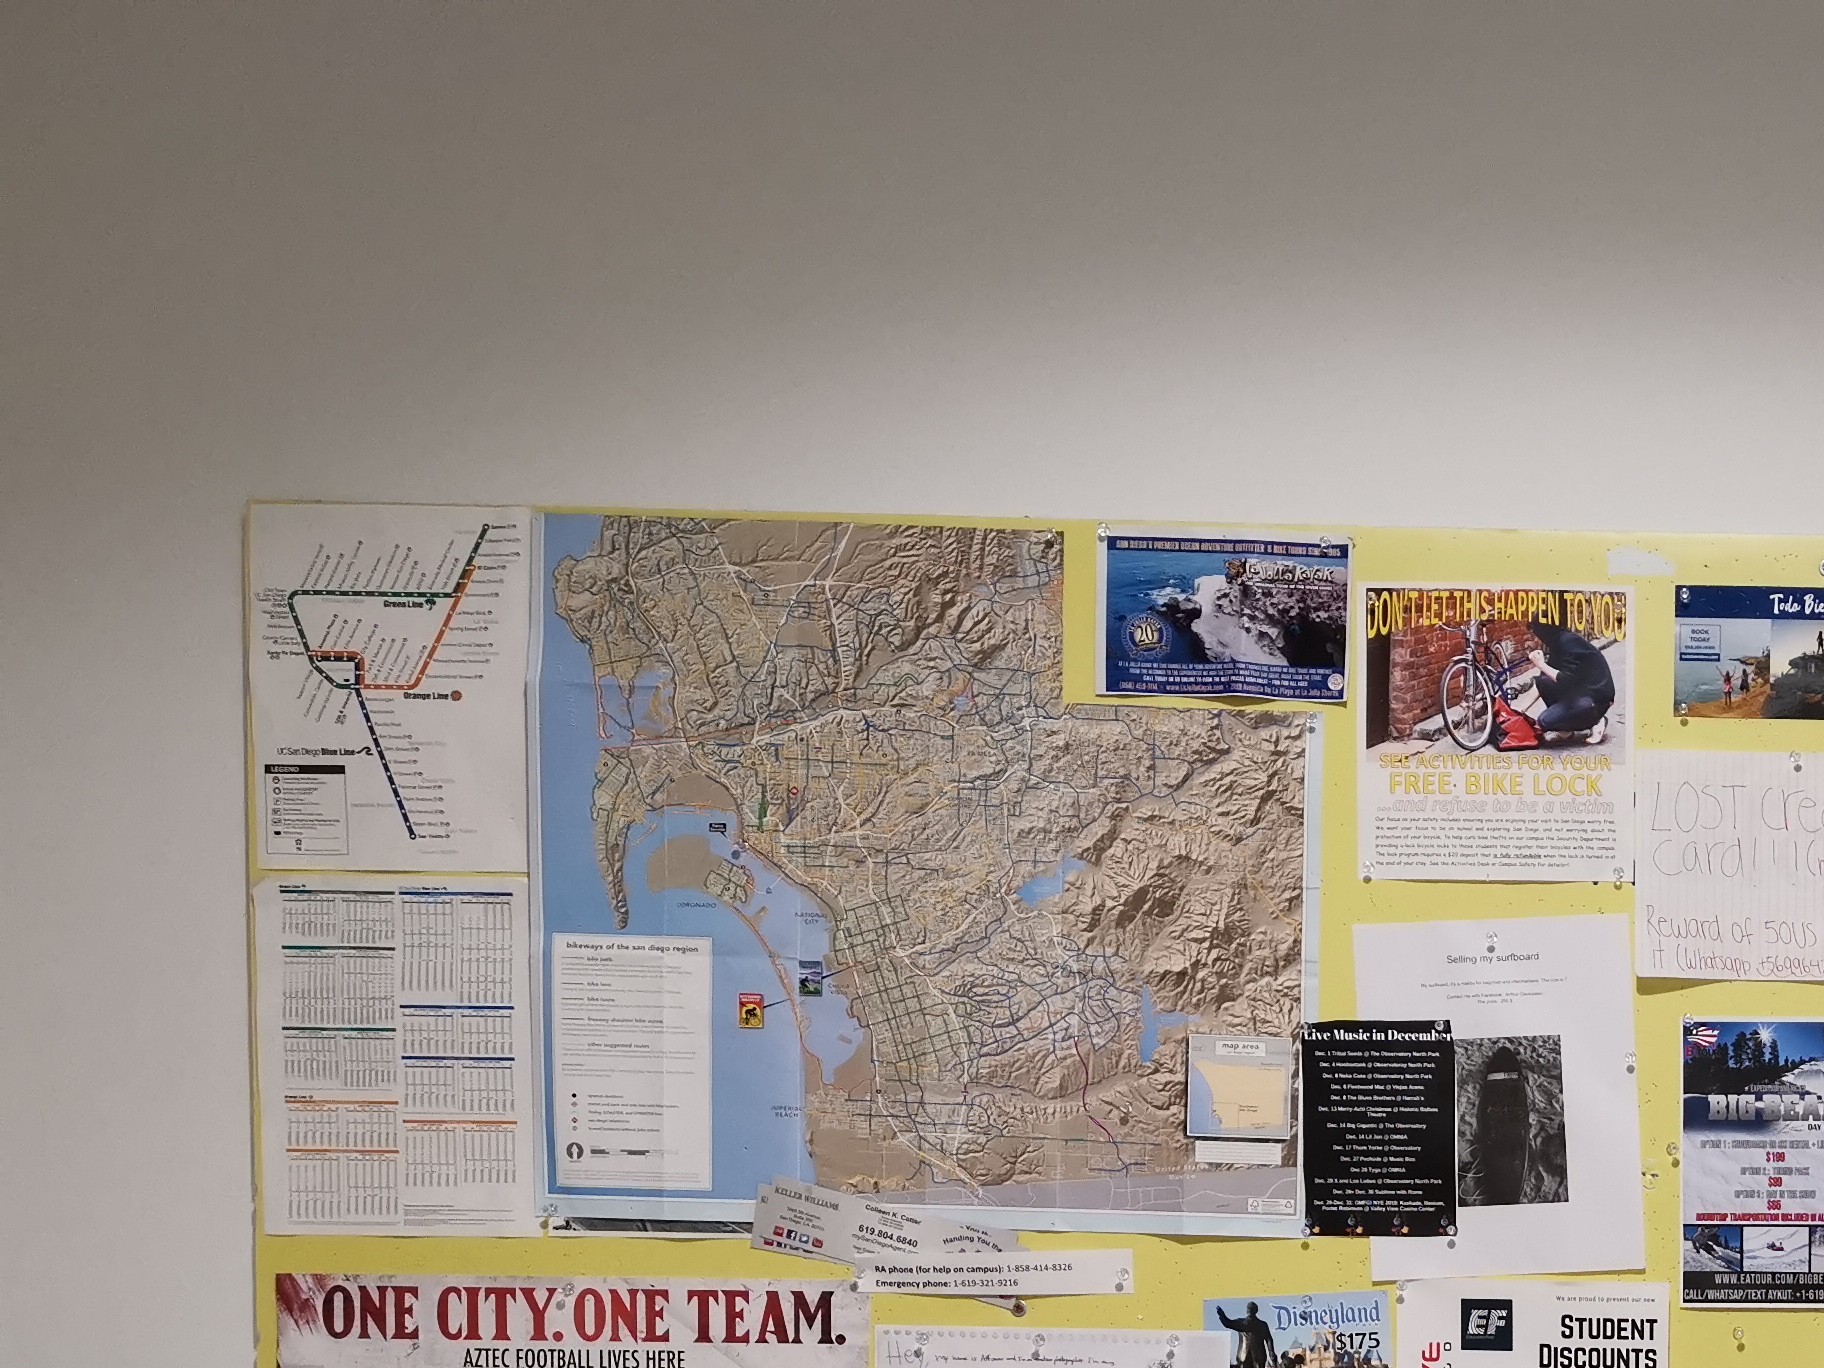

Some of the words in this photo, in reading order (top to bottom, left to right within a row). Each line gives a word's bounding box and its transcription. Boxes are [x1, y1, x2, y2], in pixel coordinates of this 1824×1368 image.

[383, 600, 405, 608] Green
[407, 601, 423, 609] Line
[1769, 593, 1801, 615] Todo
[1367, 589, 1417, 640] DON'T
[1422, 589, 1450, 625] LET
[1453, 589, 1489, 622] THIS
[1494, 589, 1561, 627] HAPPEN
[1564, 591, 1589, 632] TO
[1591, 592, 1627, 642] YOU
[403, 692, 431, 701] Orange
[433, 692, 449, 700] Line
[1389, 773, 1451, 795] FREE
[1464, 773, 1523, 796] BIKE
[1532, 773, 1603, 796] LOCK
[566, 942, 603, 951] bikeways
[648, 945, 670, 953] diego
[672, 945, 698, 953] region
[1446, 953, 1477, 964] Selling
[1480, 955, 1493, 963] my
[1496, 952, 1540, 962] surfboard
[1304, 1029, 1330, 1041] Live
[1332, 1030, 1370, 1042] Music
[1372, 1030, 1385, 1041] in
[1387, 1029, 1452, 1042] December
[858, 1224, 918, 1248] 619.804.6840
[875, 1278, 922, 1290] Emergency
[924, 1279, 951, 1289] phone:
[953, 1278, 1019, 1288] 1-619-321-9216
[322, 1284, 421, 1340] ONE
[437, 1286, 564, 1342] CITY.
[573, 1287, 671, 1343] ONE
[687, 1289, 846, 1346] TEAM.
[1271, 1299, 1382, 1332] Disneyland
[1560, 1314, 1658, 1341] STUDENT
[1336, 1333, 1380, 1352] $175
[463, 1348, 511, 1368] AZTEC
